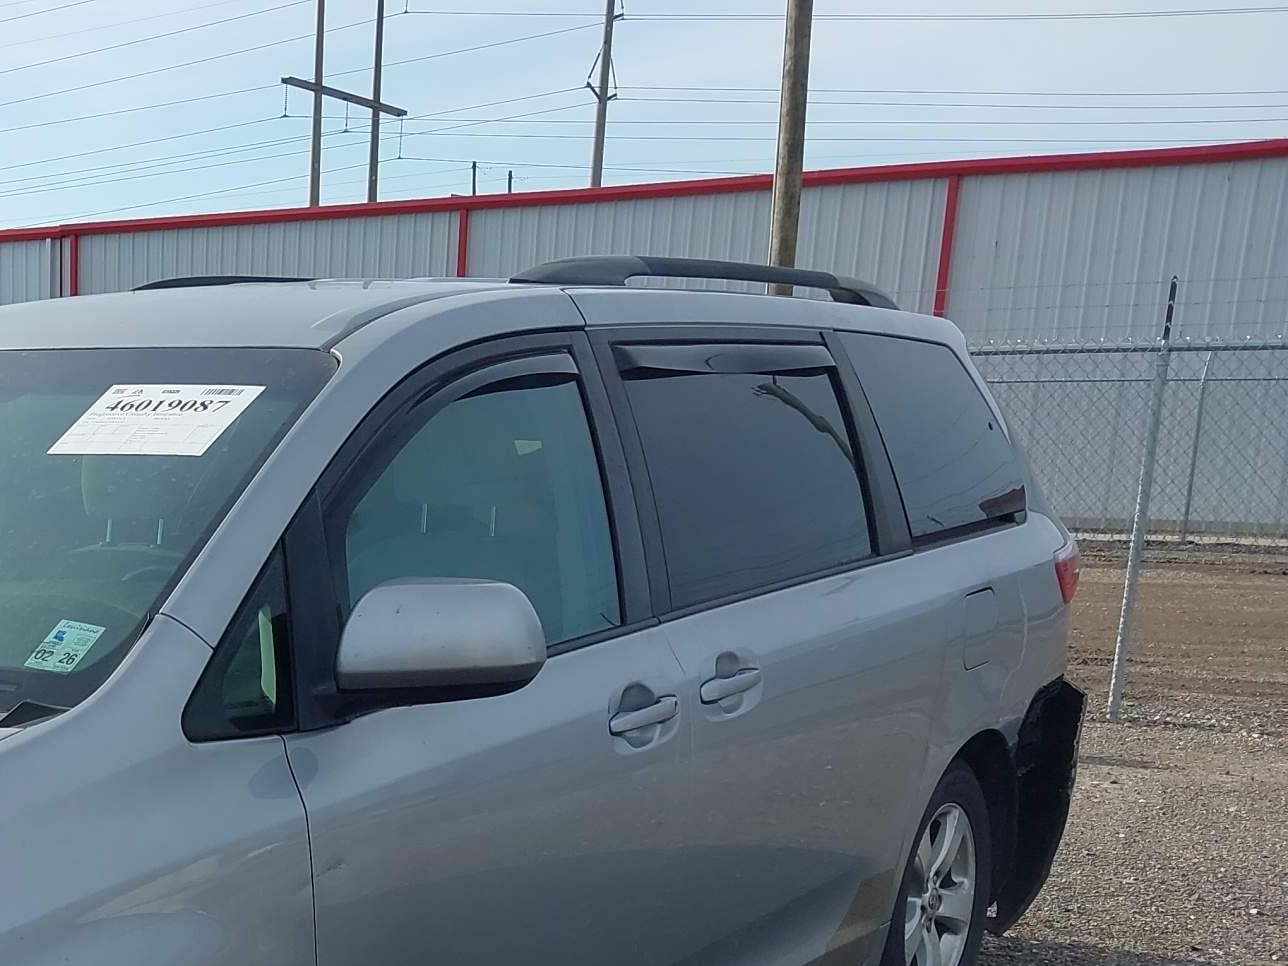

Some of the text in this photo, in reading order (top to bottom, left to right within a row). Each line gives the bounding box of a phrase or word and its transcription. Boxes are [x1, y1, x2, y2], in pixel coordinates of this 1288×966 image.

[105, 399, 232, 414] 46019087
[34, 649, 78, 665] 02 26
